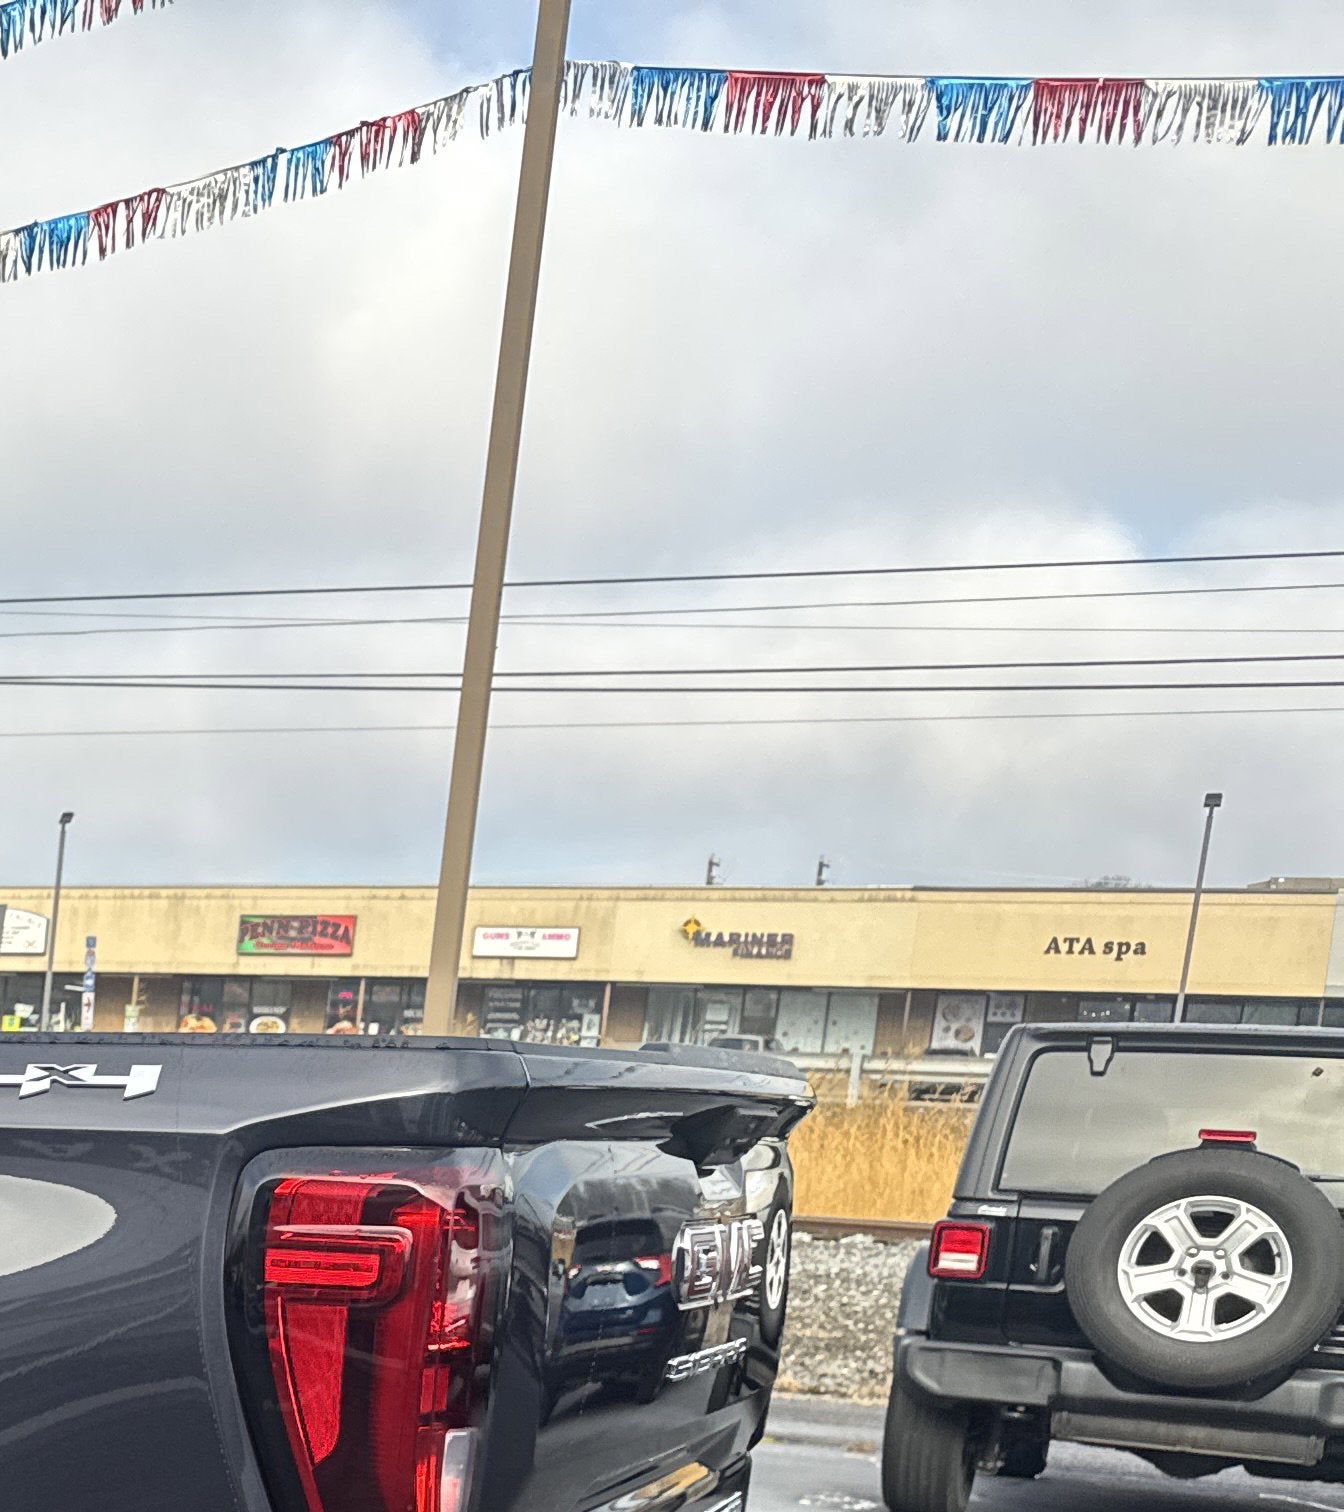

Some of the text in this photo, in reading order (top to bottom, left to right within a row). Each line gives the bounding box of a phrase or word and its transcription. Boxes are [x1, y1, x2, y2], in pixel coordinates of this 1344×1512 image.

[238, 918, 352, 944] PENN PIZZA
[694, 931, 793, 947] MARINER
[1044, 936, 1146, 961] ATA spa
